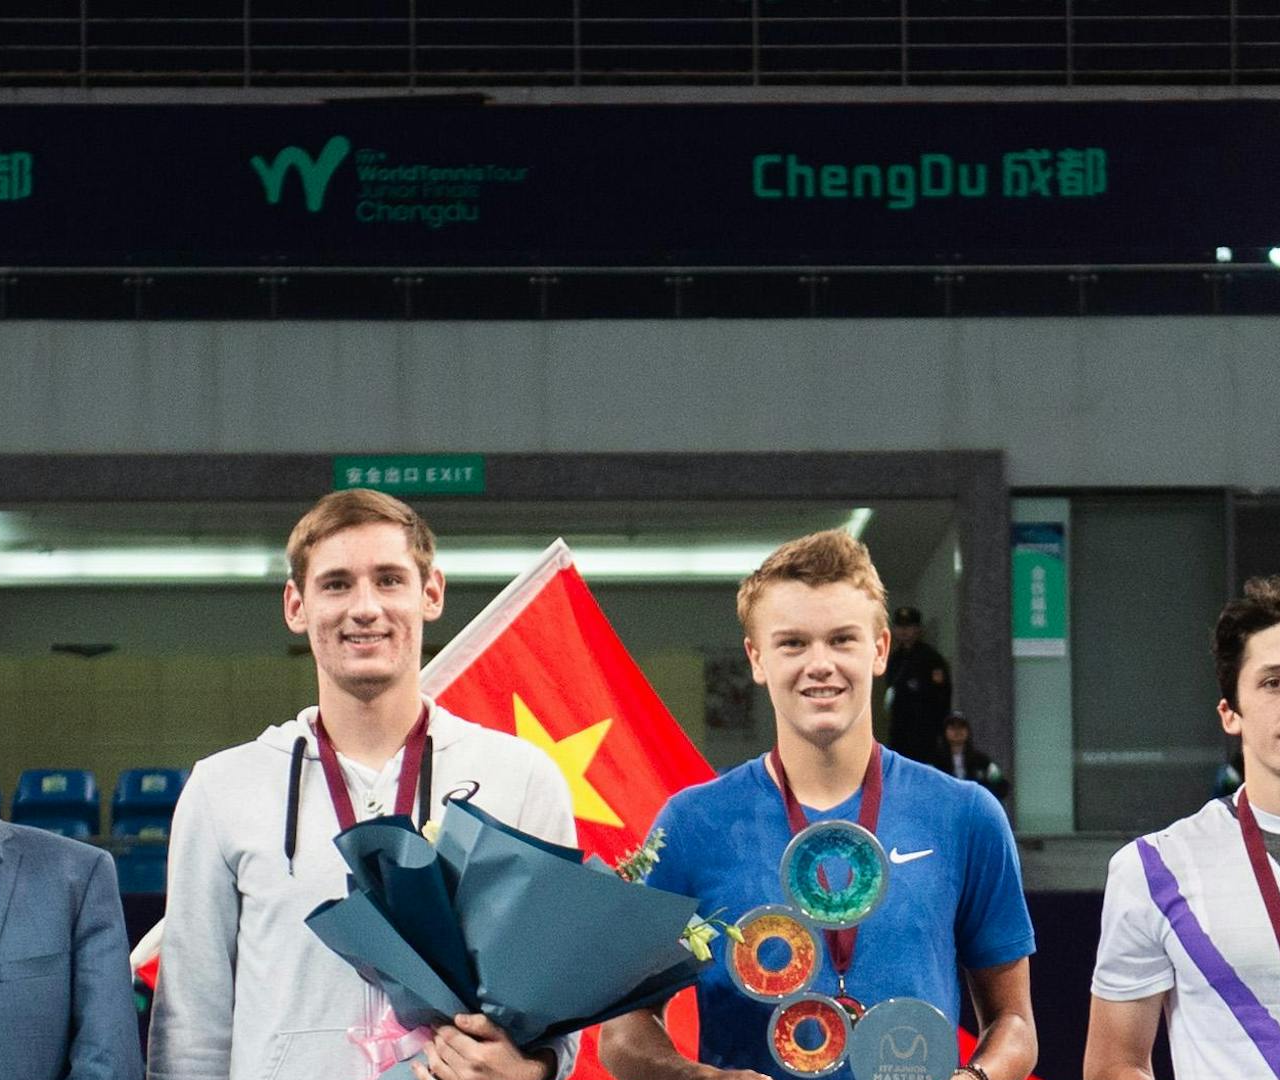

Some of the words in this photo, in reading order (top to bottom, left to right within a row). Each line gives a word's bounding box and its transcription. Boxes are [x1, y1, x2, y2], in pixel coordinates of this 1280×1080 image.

[751, 151, 991, 211] ChengDu
[1000, 146, 1110, 199] 成都
[355, 199, 481, 231] Chengdu
[425, 466, 474, 483] EXIT
